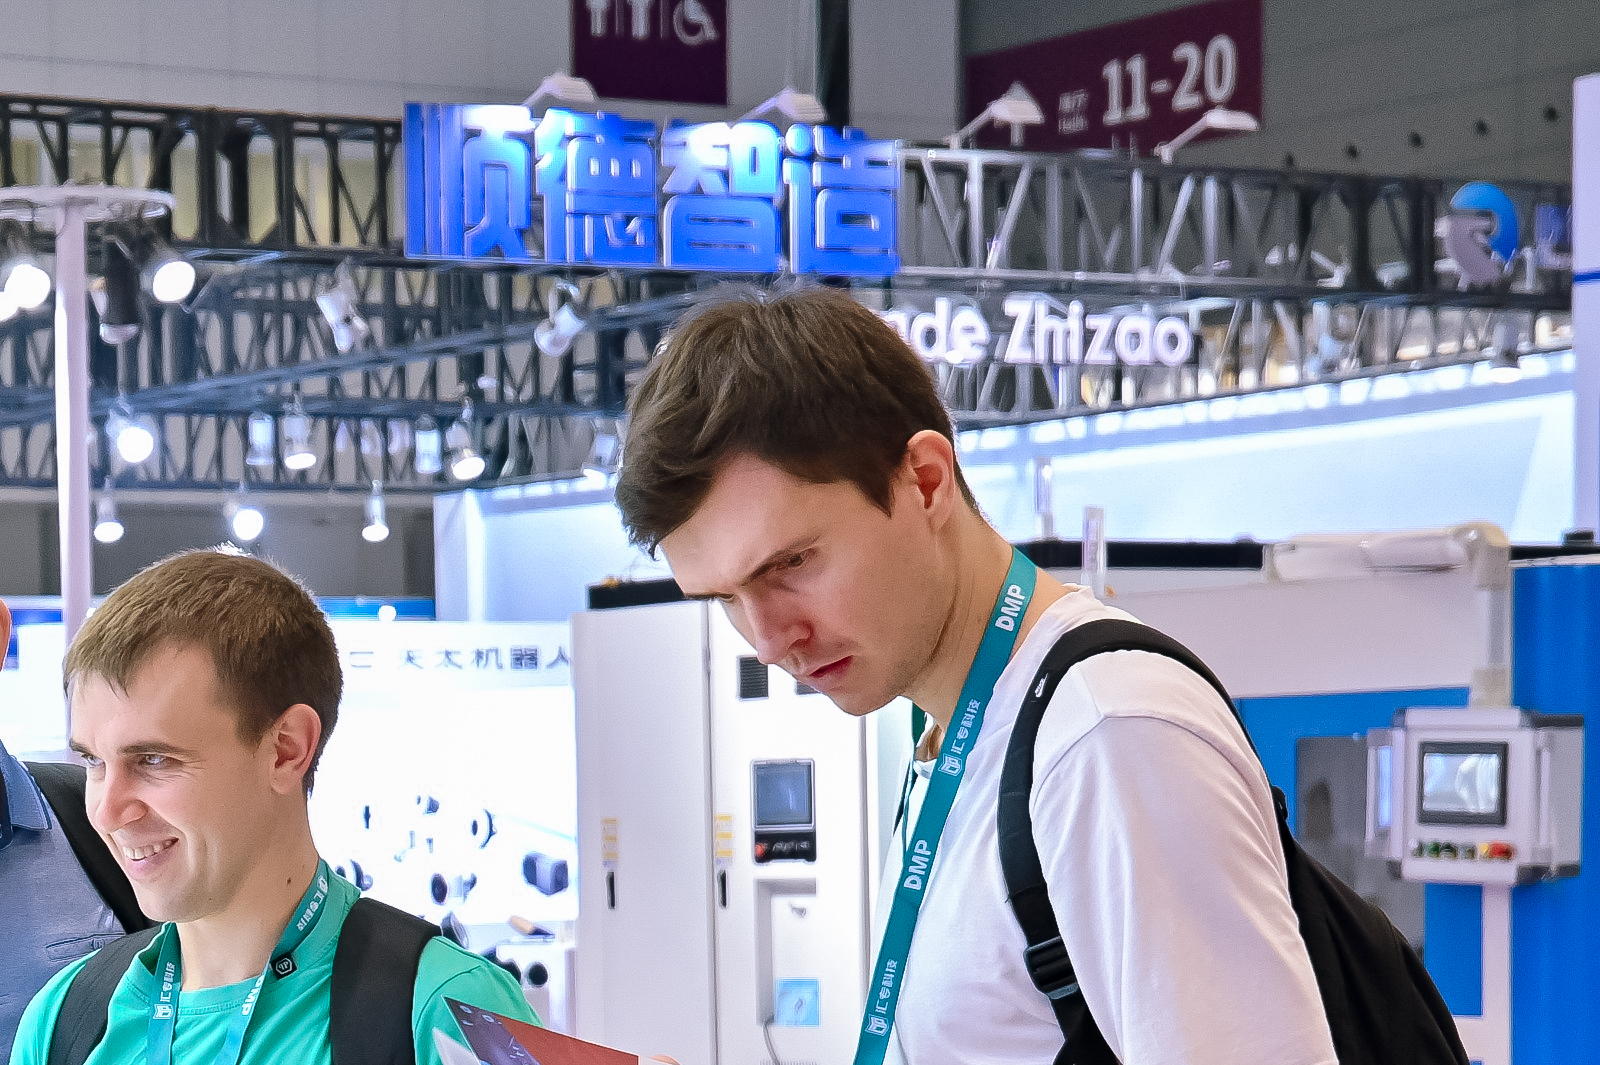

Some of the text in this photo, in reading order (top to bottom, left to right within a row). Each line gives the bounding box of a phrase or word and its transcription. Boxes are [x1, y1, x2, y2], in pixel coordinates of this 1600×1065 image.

[1103, 35, 1237, 127] 11-20
[403, 103, 900, 273] 顺德智造
[1004, 299, 1194, 367] Zhizao
[995, 584, 1026, 632] DMP
[904, 839, 932, 891] DMP
